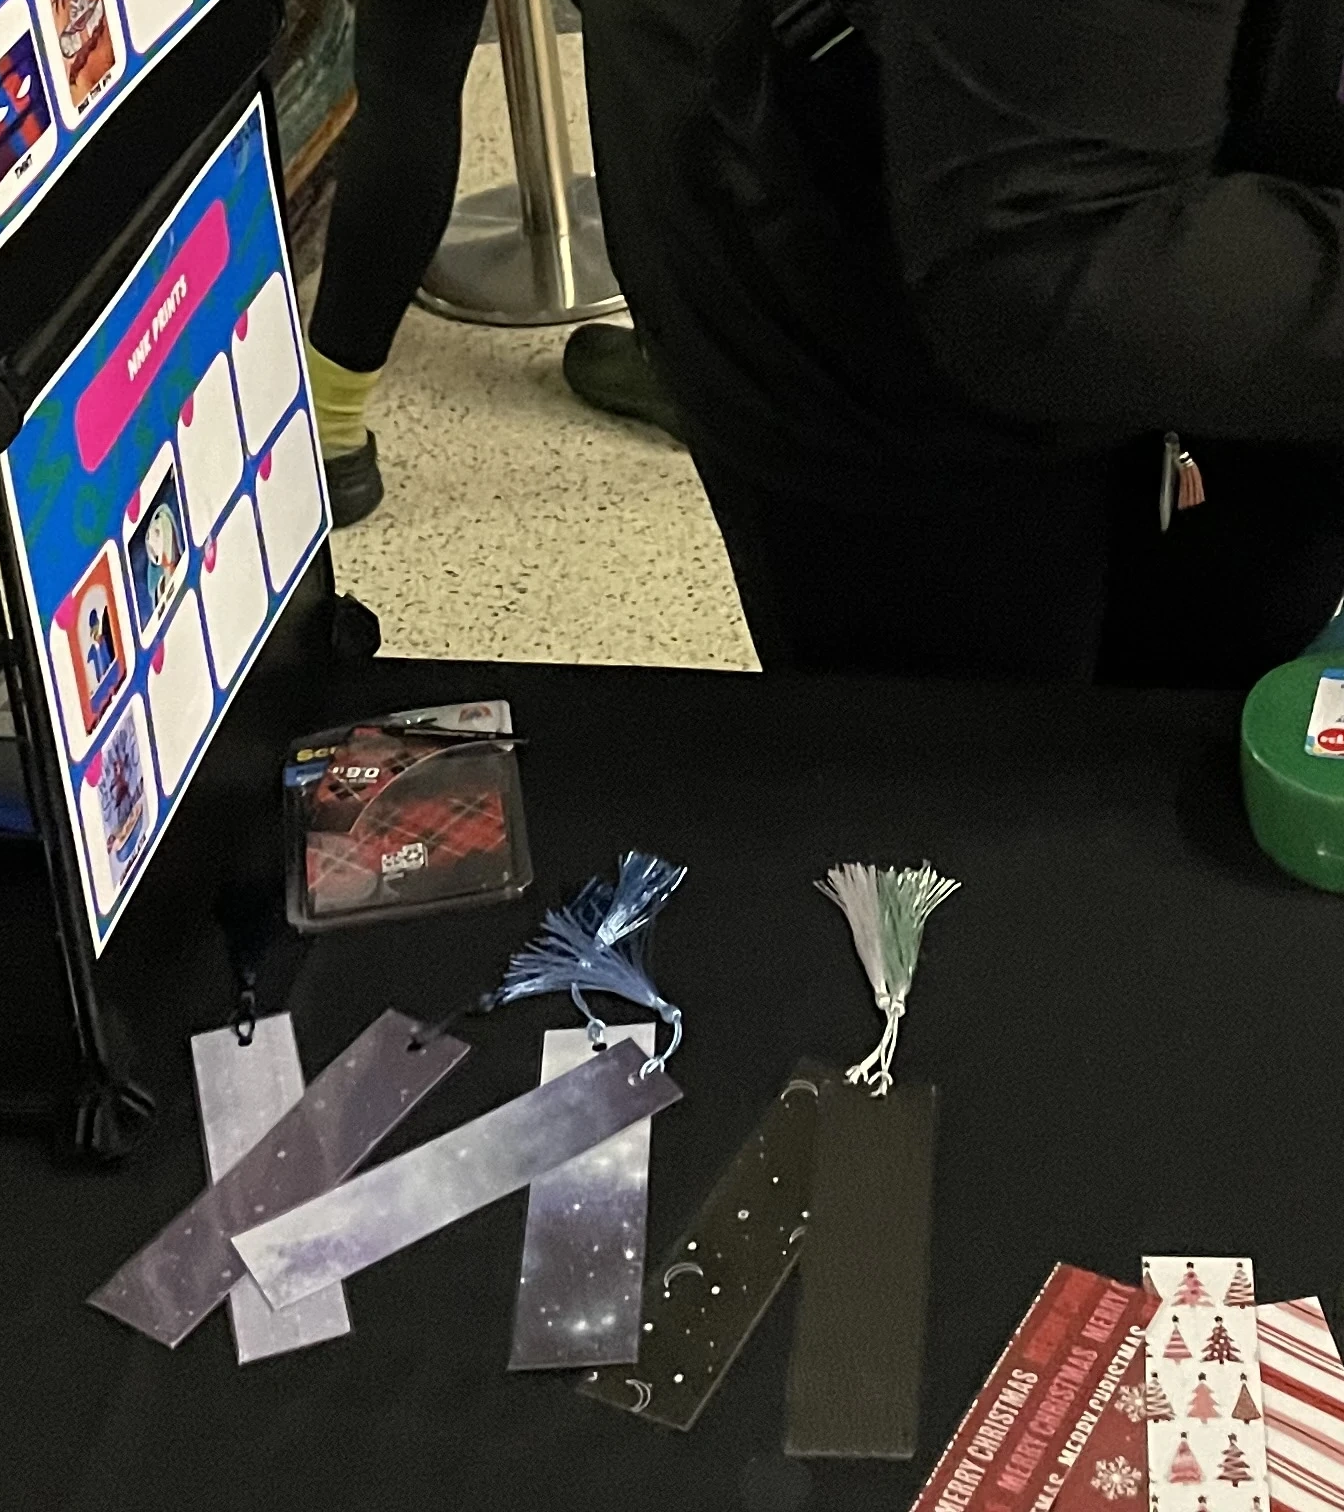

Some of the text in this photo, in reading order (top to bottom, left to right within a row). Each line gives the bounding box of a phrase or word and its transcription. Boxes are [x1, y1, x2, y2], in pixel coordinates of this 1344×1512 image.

[127, 273, 188, 382] NNK PRINTS
[1081, 1286, 1130, 1343] MERRY
[934, 1368, 1038, 1512] MERRY CHRISTMAS
[997, 1435, 1048, 1494] MERRY
[1029, 1345, 1098, 1436] CHRISTMAS
